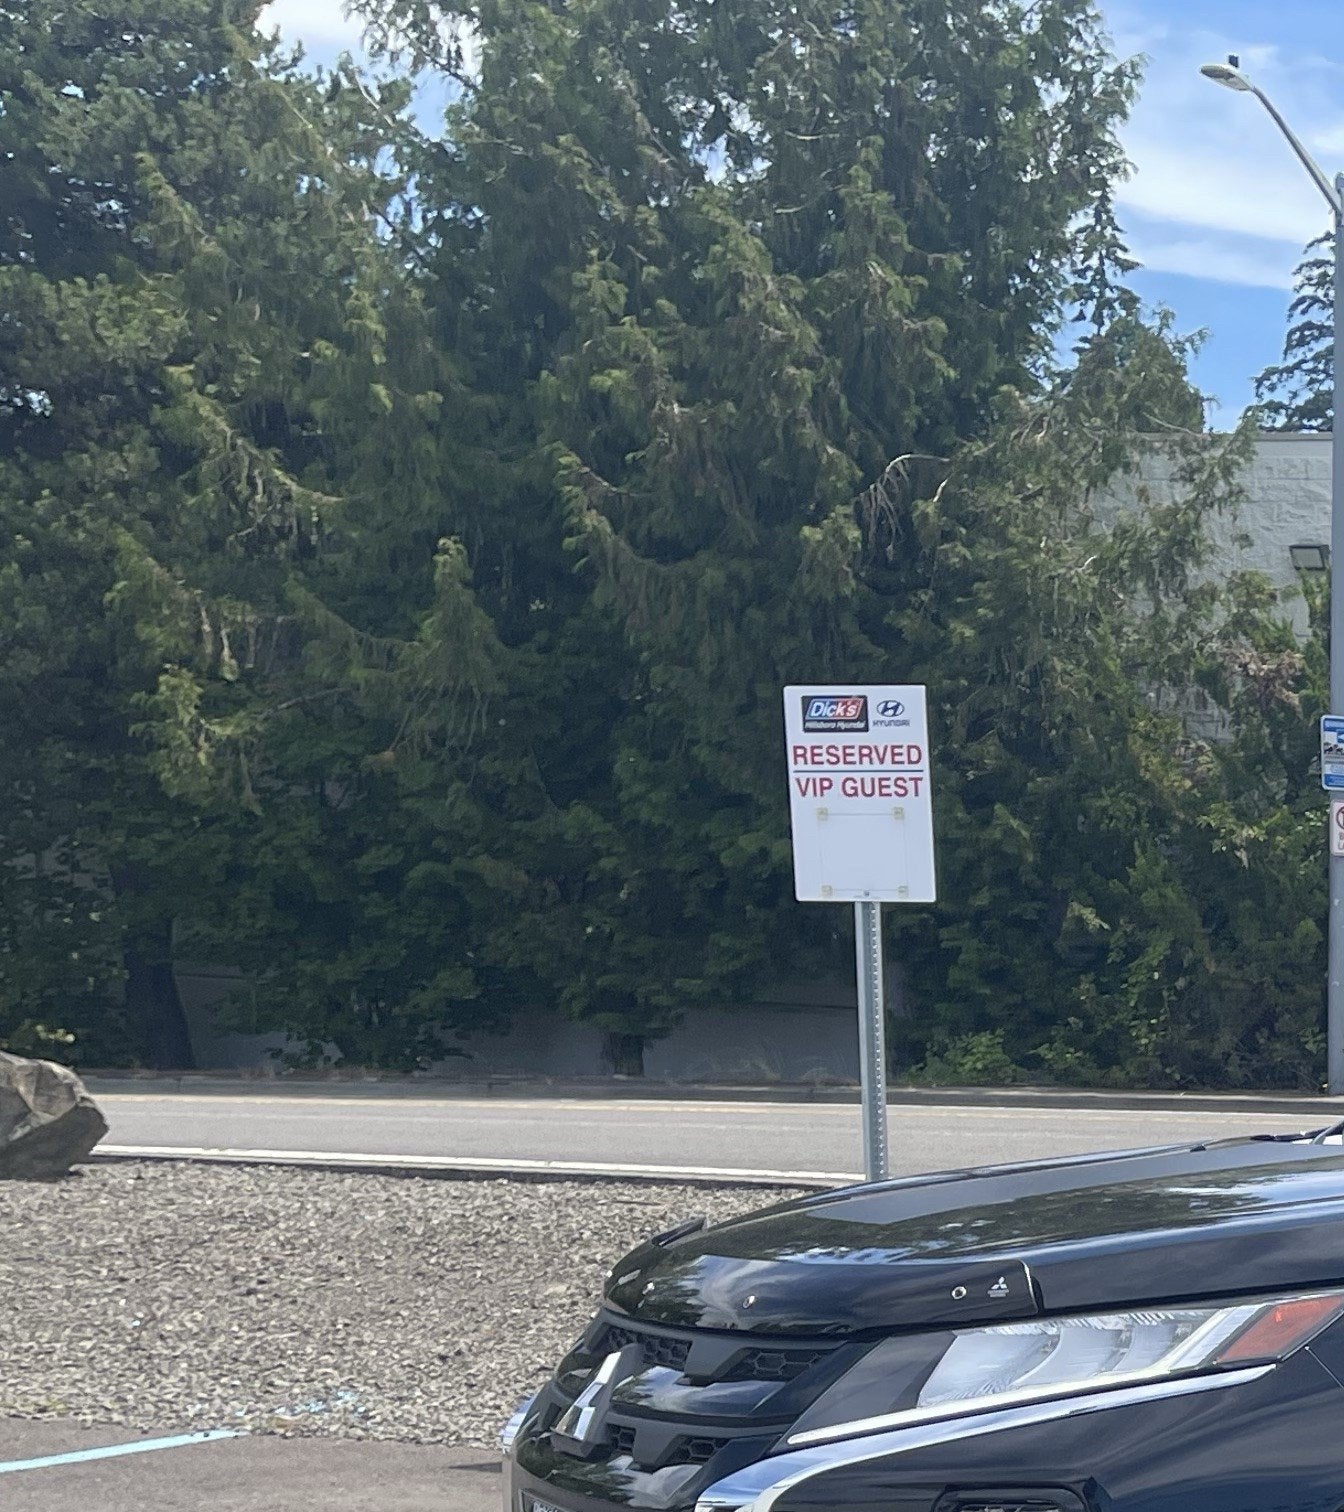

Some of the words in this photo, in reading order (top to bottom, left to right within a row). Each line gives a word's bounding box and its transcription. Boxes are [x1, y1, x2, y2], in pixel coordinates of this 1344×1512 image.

[810, 700, 858, 718] Dick's
[872, 719, 911, 728] HYUNDAI
[793, 744, 923, 766] RESERVED
[795, 776, 834, 798] VIP
[841, 776, 924, 798] GUEST
